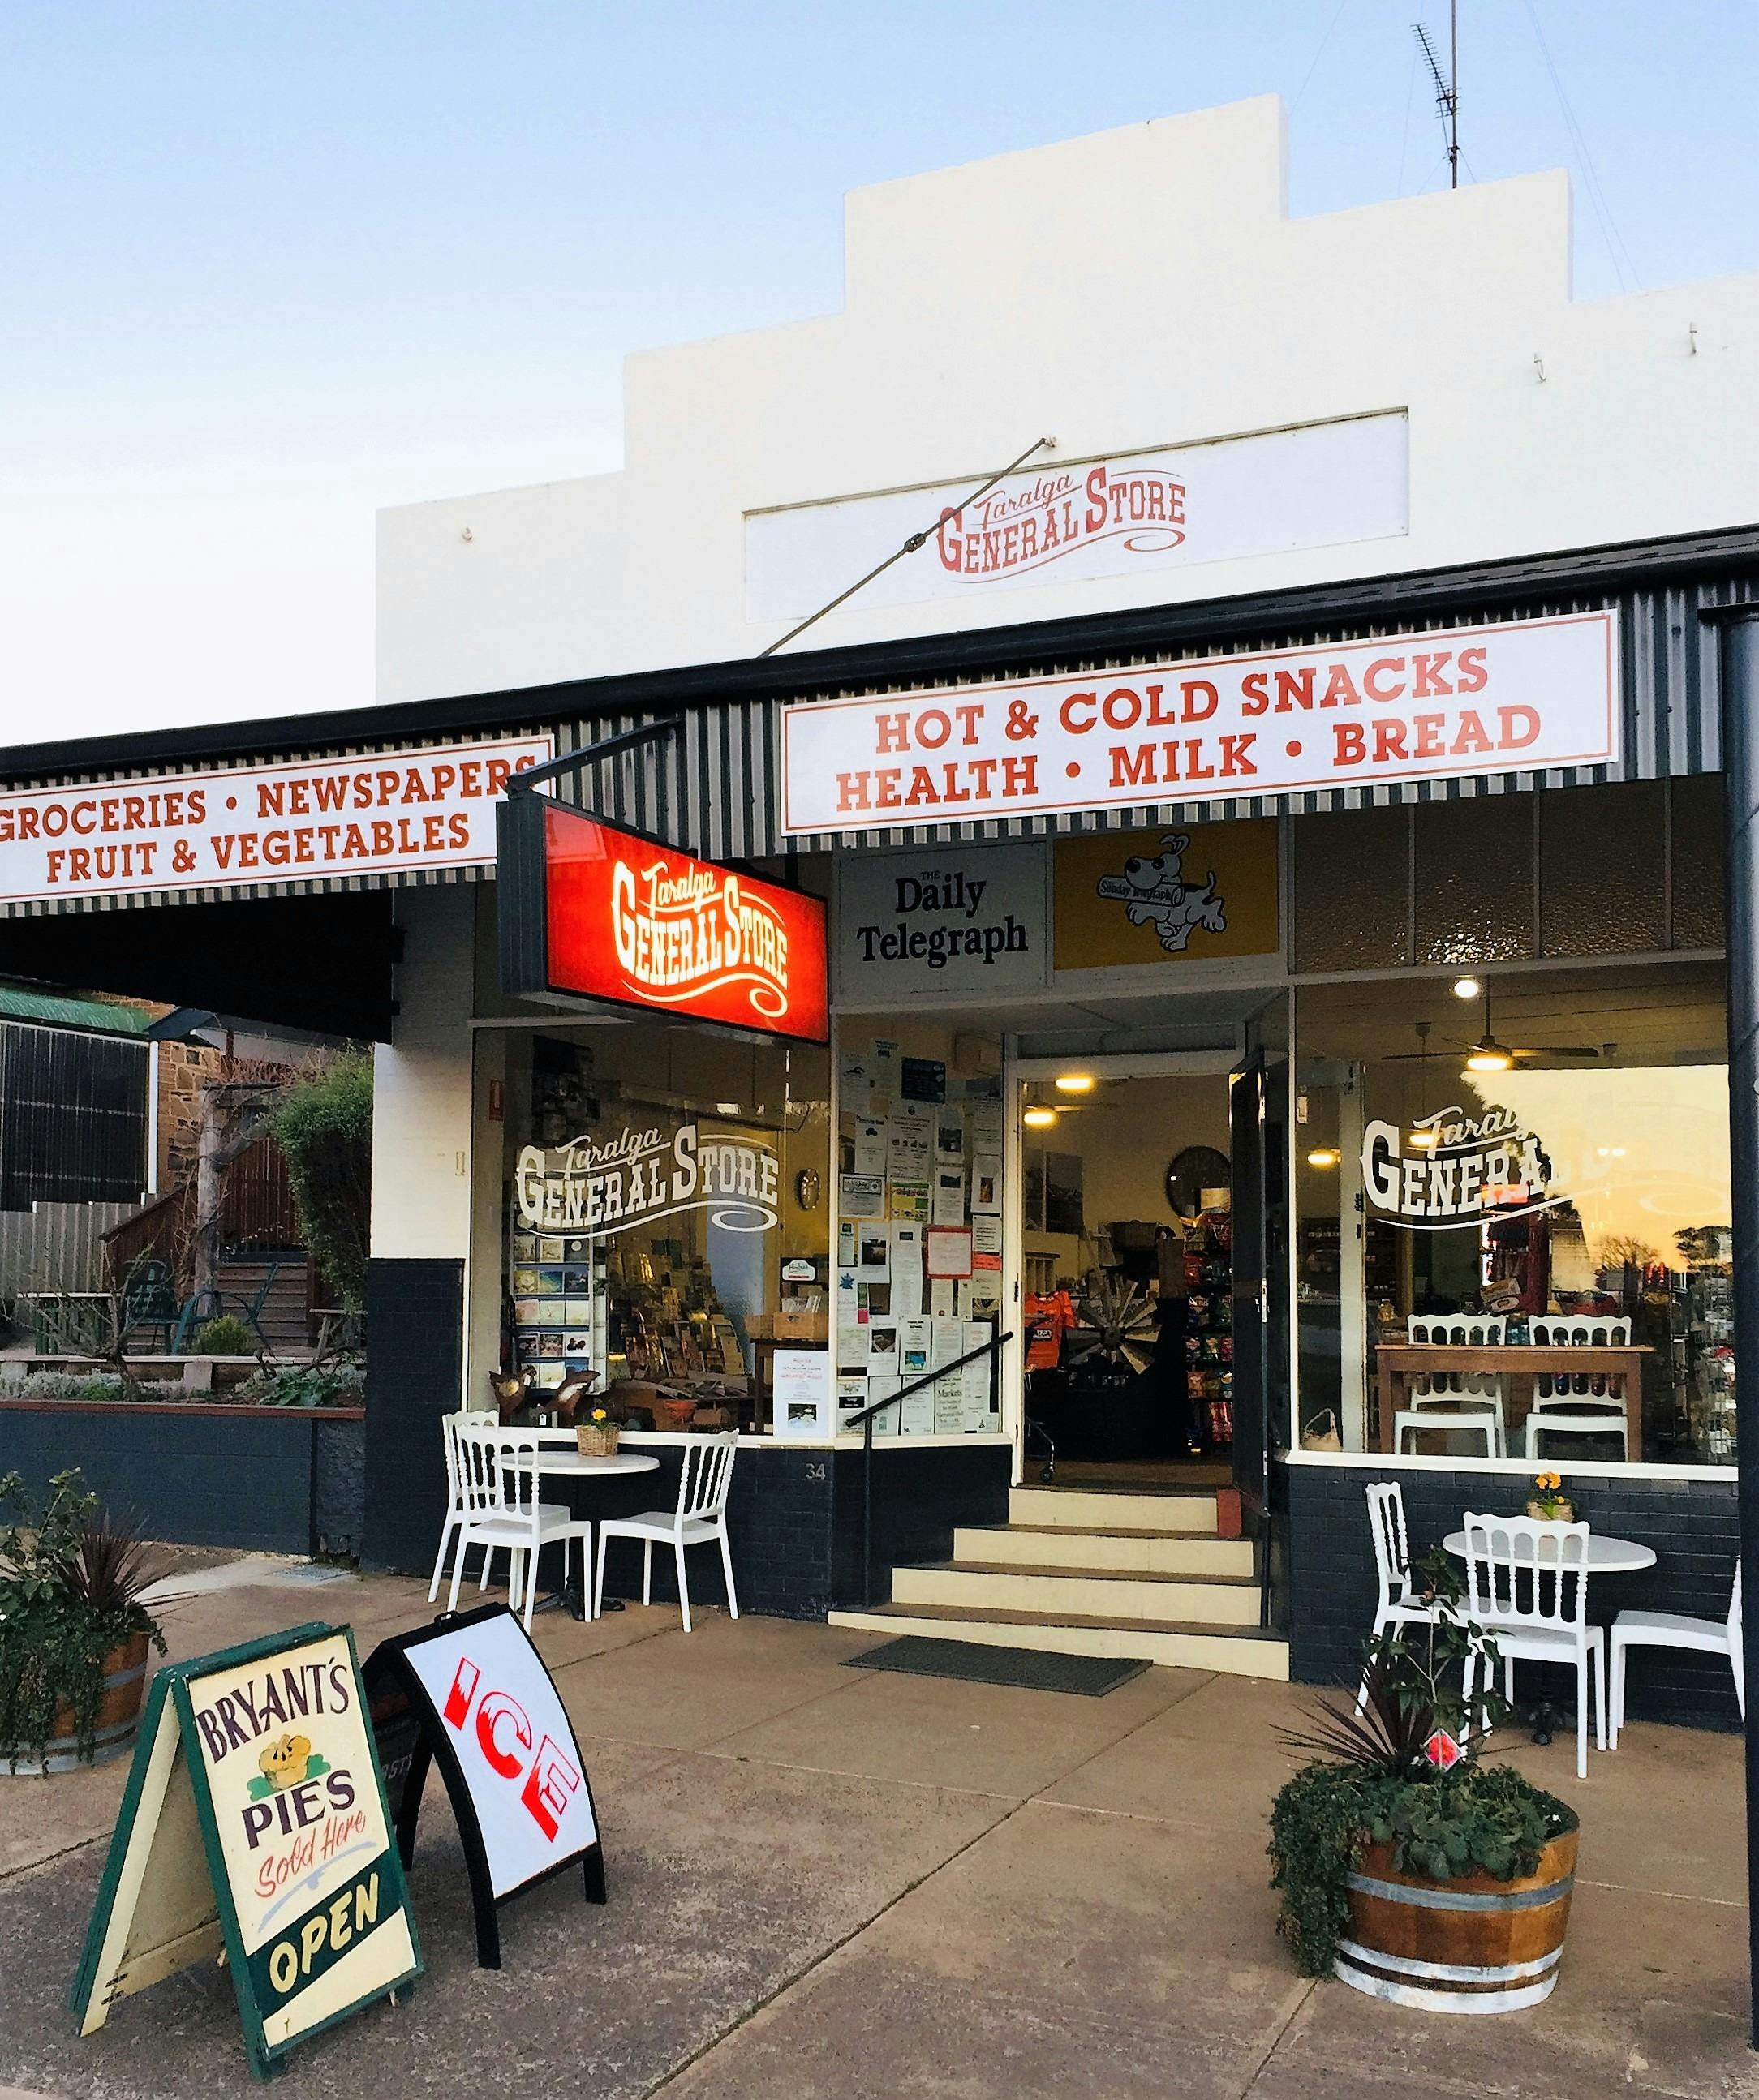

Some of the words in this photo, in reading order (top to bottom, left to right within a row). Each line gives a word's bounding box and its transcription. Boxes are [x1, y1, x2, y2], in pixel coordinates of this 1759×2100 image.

[936, 501, 1078, 573] GENERAL
[1086, 467, 1185, 534] STORE
[973, 475, 1075, 530] Taralga
[875, 705, 984, 754] HOT
[1005, 700, 1039, 741] &
[1059, 681, 1219, 735] COLD
[1241, 648, 1488, 715] SNACKS
[836, 755, 1039, 811] HEALTH
[1108, 733, 1257, 788] MILK
[1333, 705, 1541, 766] BREAD
[0, 790, 206, 843] GROCERIES
[47, 842, 157, 883] FRUIT
[172, 839, 196, 873] &
[210, 813, 470, 870] VEGETABLES
[641, 861, 716, 919] Taralga
[894, 872, 987, 918] Daily
[920, 870, 940, 881] THE
[611, 860, 721, 986] GENERAL
[723, 876, 788, 990] STORE
[857, 915, 1028, 968] Telegraph
[517, 1145, 666, 1228] GENERAL
[673, 1125, 779, 1206] STORE
[555, 1127, 662, 1180] Taralga
[1360, 1120, 1558, 1217] GENERA
[806, 1463, 826, 1480] 34
[197, 1657, 350, 1763] BRYANT'S
[443, 1657, 580, 1843] ICE
[242, 1769, 355, 1849] PIES
[254, 1829, 316, 1897] Sold
[322, 1810, 368, 1860] Here
[269, 1873, 379, 1993] OPEN
